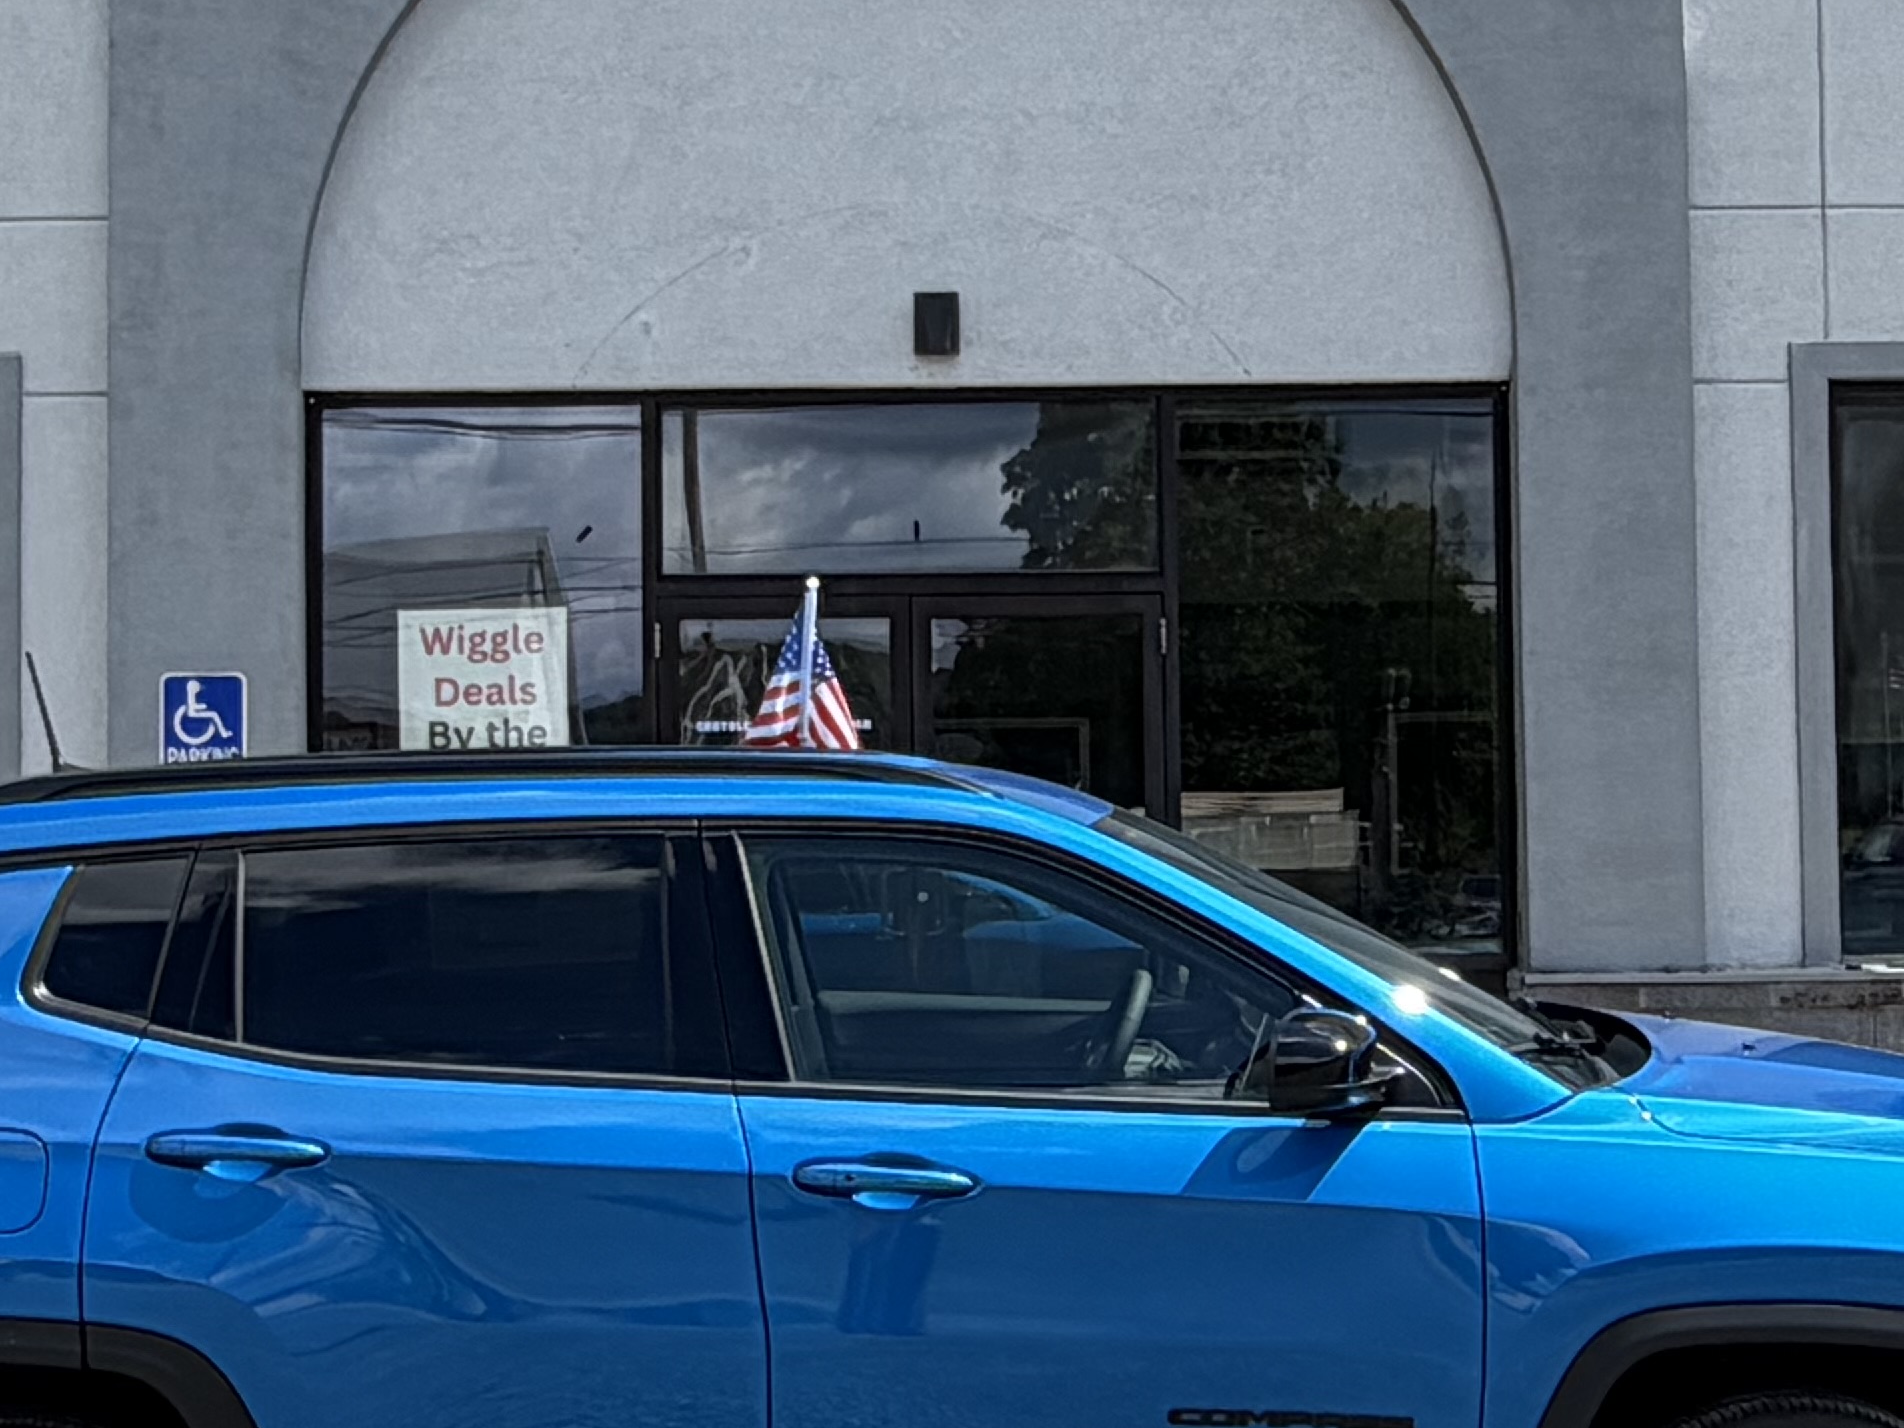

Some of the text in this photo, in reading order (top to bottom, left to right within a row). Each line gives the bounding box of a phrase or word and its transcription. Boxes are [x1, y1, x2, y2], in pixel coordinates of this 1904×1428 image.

[419, 622, 544, 663] Wiggle
[434, 674, 537, 707] Deals
[429, 716, 547, 750] By the
